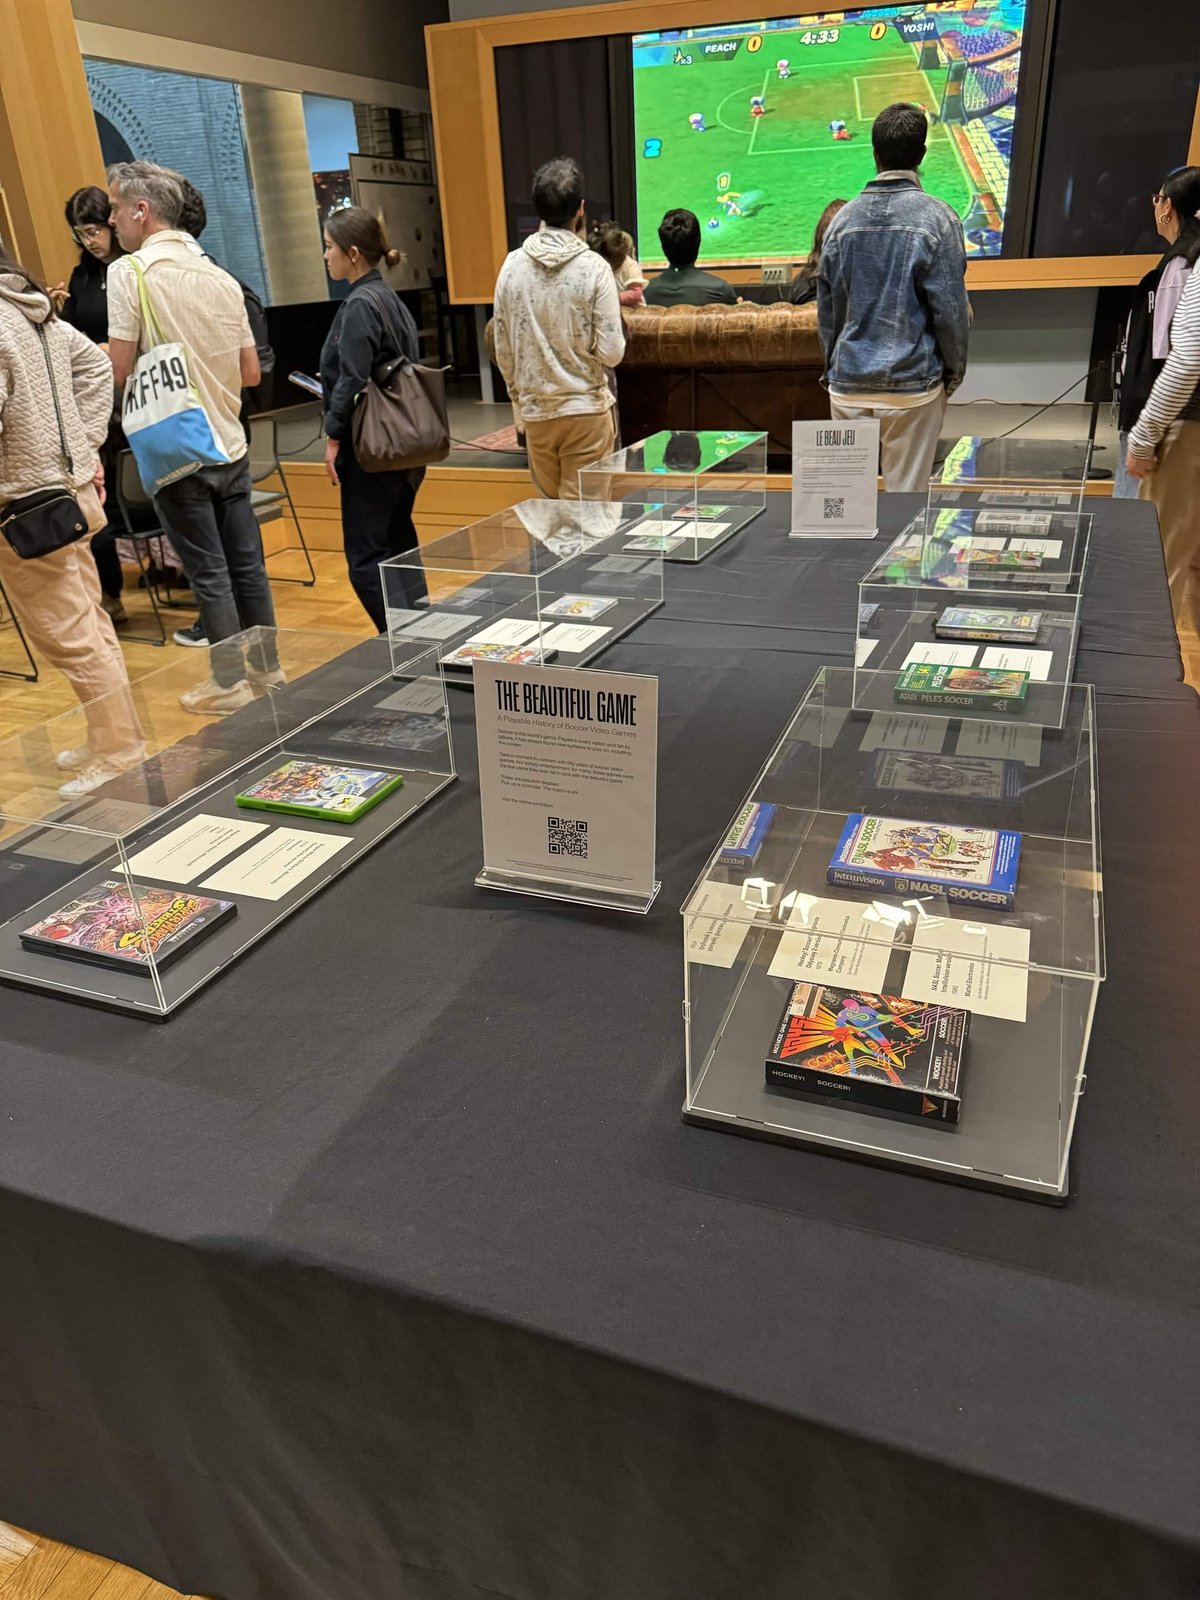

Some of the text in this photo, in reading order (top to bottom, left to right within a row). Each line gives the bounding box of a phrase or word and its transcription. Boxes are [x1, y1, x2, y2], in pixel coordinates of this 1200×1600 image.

[870, 21, 887, 40] 0
[902, 21, 935, 33] YOSHI
[746, 35, 762, 53] 0
[800, 29, 840, 45] 4:33
[704, 42, 738, 54] PEACH
[644, 138, 662, 158] 2
[816, 430, 855, 446] LE BEAU JEU
[495, 680, 637, 726] THE BEAUTIFUL GAME
[944, 696, 973, 705] SOCCER
[504, 715, 530, 726] Playable
[532, 719, 554, 729] History
[564, 723, 588, 732] Soccer
[590, 726, 609, 734] Video
[612, 728, 636, 738] Games
[861, 819, 877, 841] SOCCER
[910, 882, 947, 895] NASL
[949, 887, 1008, 905] SOCCER
[772, 1070, 850, 1091] HOCKEY! SOCCER!
